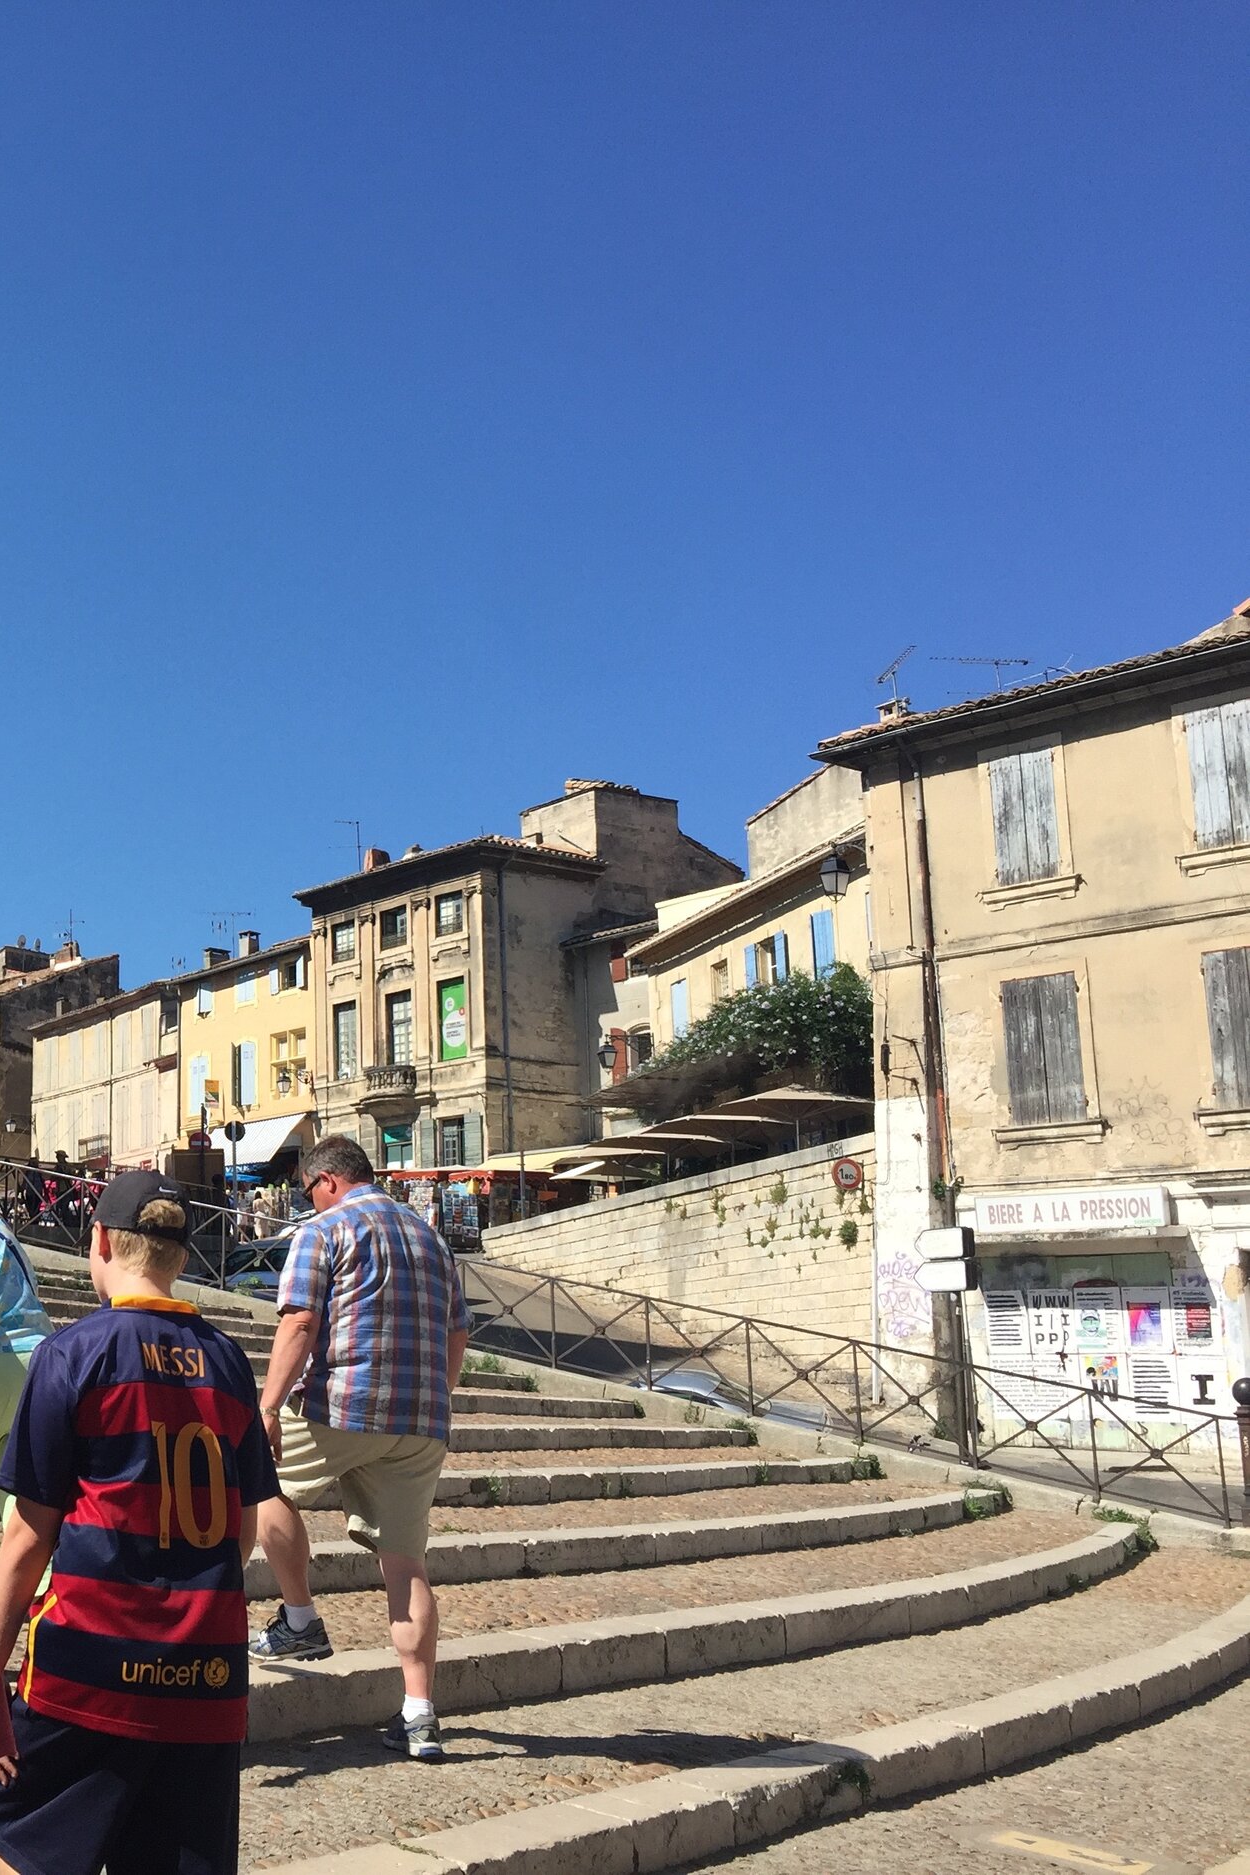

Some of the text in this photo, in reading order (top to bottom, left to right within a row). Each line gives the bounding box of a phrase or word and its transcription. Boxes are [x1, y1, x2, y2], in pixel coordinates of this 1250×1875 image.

[987, 1196, 1152, 1225] BIERE A LA PRESSION
[141, 1341, 207, 1379] MESSI
[151, 1421, 228, 1550] 10
[121, 1656, 201, 1687] unicef
